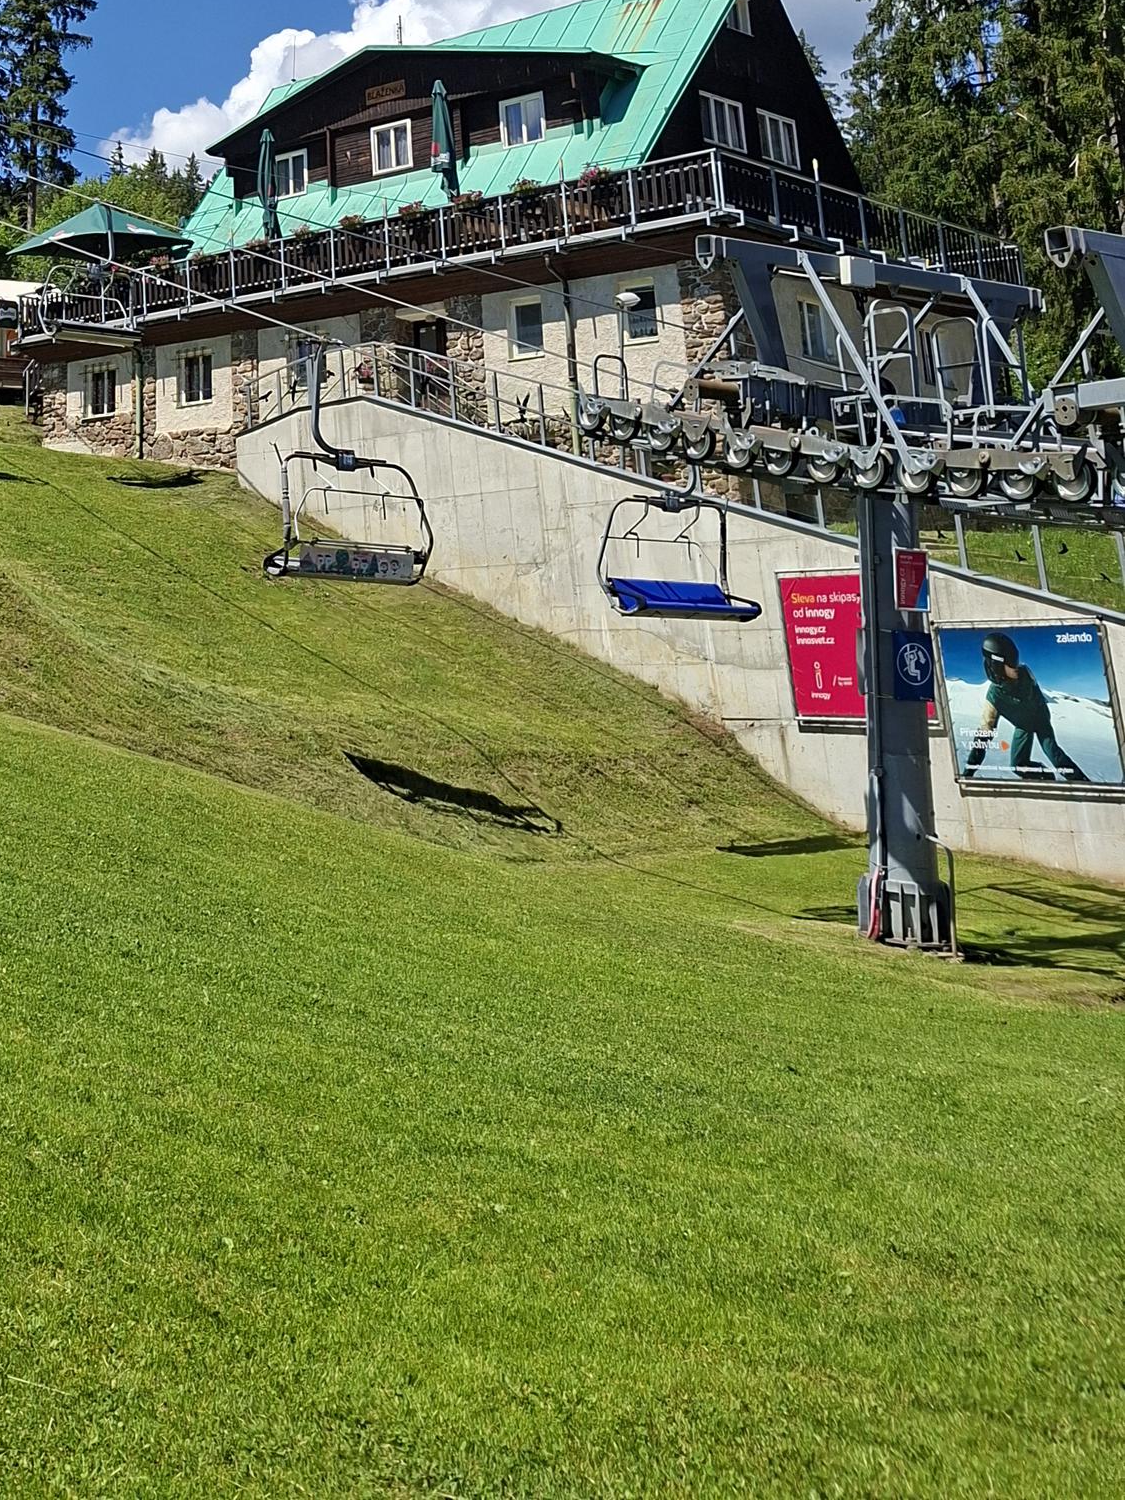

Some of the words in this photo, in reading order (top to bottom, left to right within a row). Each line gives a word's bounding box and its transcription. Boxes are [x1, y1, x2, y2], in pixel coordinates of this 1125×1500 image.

[791, 592, 815, 604] Sleva
[816, 594, 828, 603] na
[793, 606, 804, 618] od
[805, 607, 835, 619] innogy
[795, 625, 826, 635] innogy.cz
[796, 636, 835, 645] innosvet.cz
[1055, 632, 1093, 643] zalando
[811, 691, 831, 700] innogy
